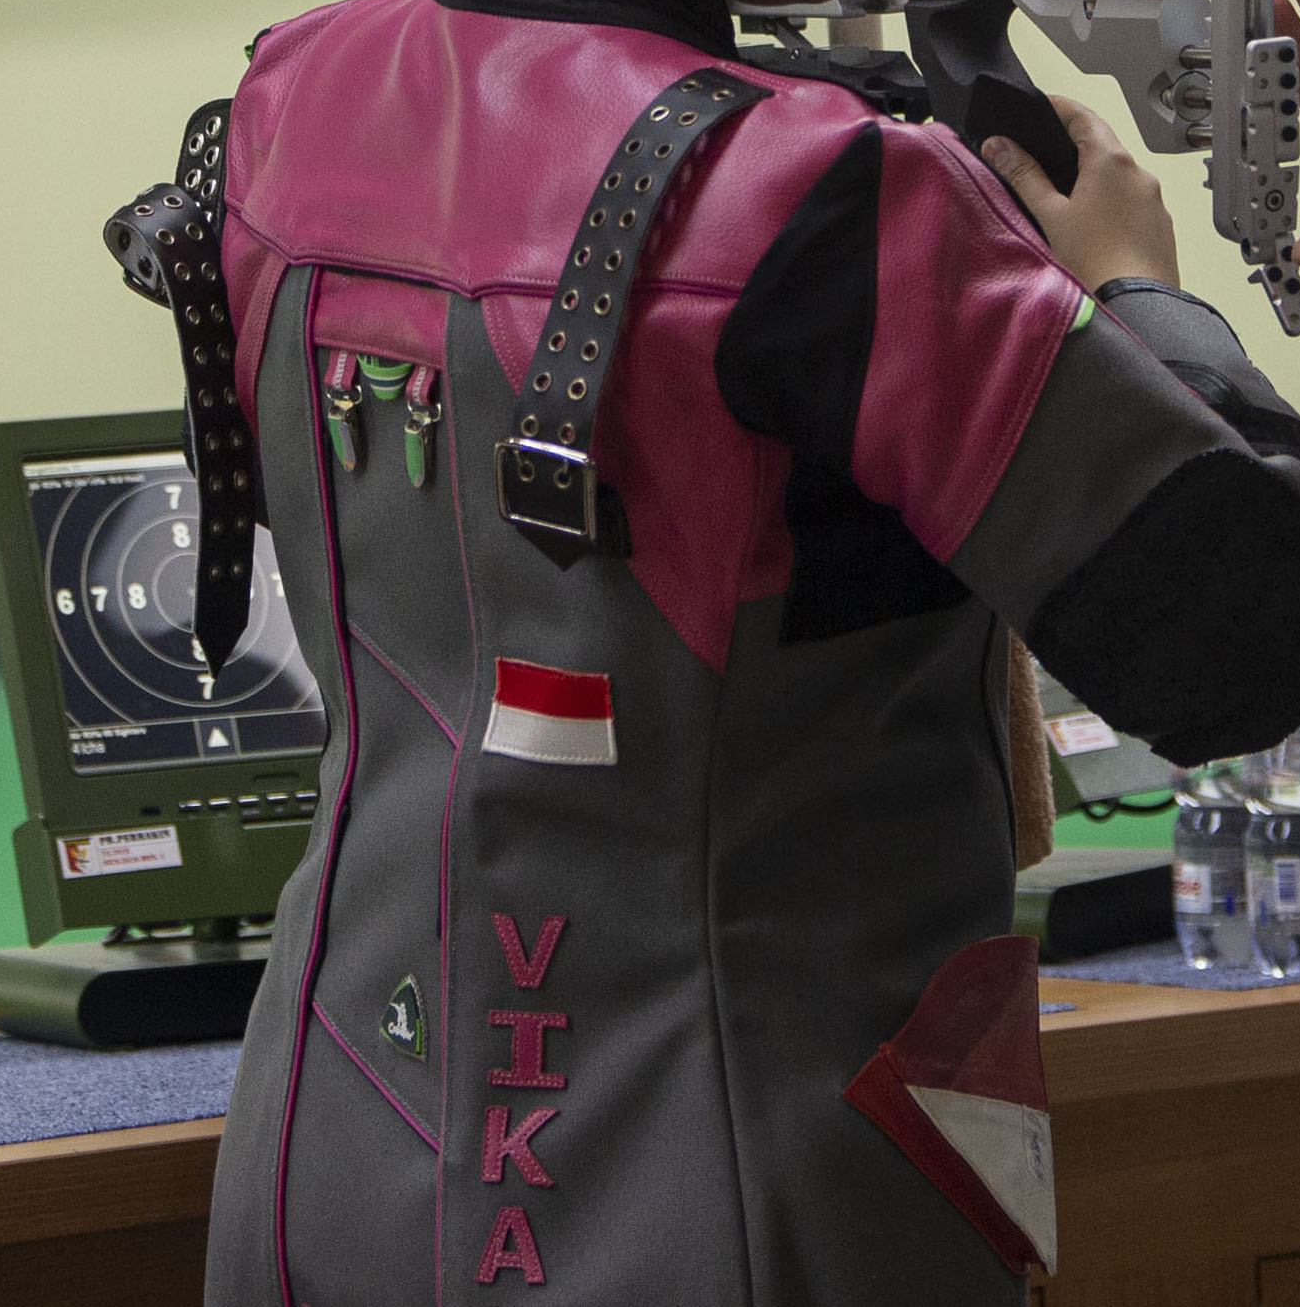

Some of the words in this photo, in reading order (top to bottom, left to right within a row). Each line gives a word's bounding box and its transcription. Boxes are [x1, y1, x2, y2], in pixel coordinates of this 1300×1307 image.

[165, 485, 182, 509] 7
[172, 522, 191, 548] 8
[56, 588, 75, 615] 6
[90, 586, 108, 612] 7
[128, 582, 147, 610] 8
[197, 673, 215, 700] 7
[474, 911, 568, 1285] VIKA
